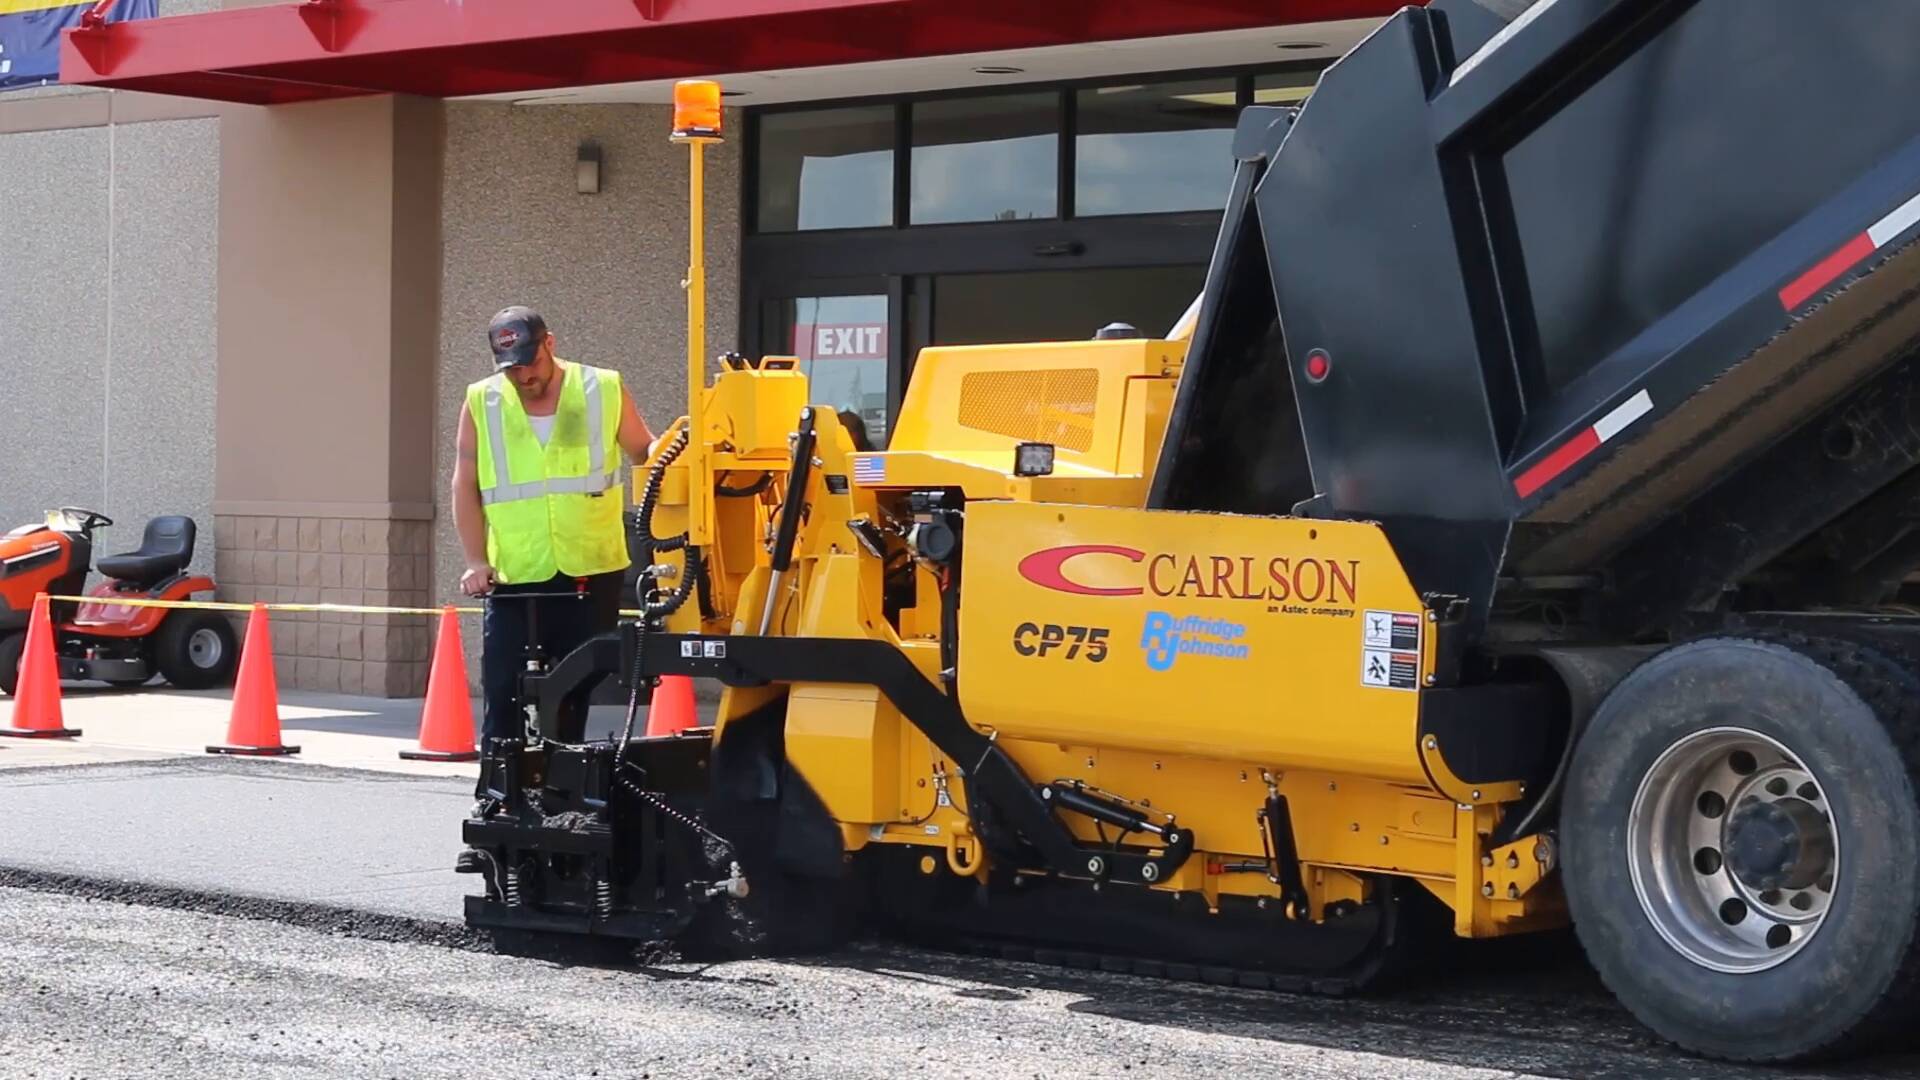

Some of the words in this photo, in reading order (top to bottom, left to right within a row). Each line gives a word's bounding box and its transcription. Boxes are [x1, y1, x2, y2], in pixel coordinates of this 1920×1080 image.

[818, 327, 881, 355] EXIT
[1148, 553, 1360, 604] CARLSON
[1267, 605, 1279, 613] an
[1281, 604, 1309, 615] Astec
[1311, 607, 1356, 618] company
[1013, 622, 1110, 663] CP75
[1141, 611, 1247, 649] Ruffridge
[1146, 634, 1250, 671] Johnson
